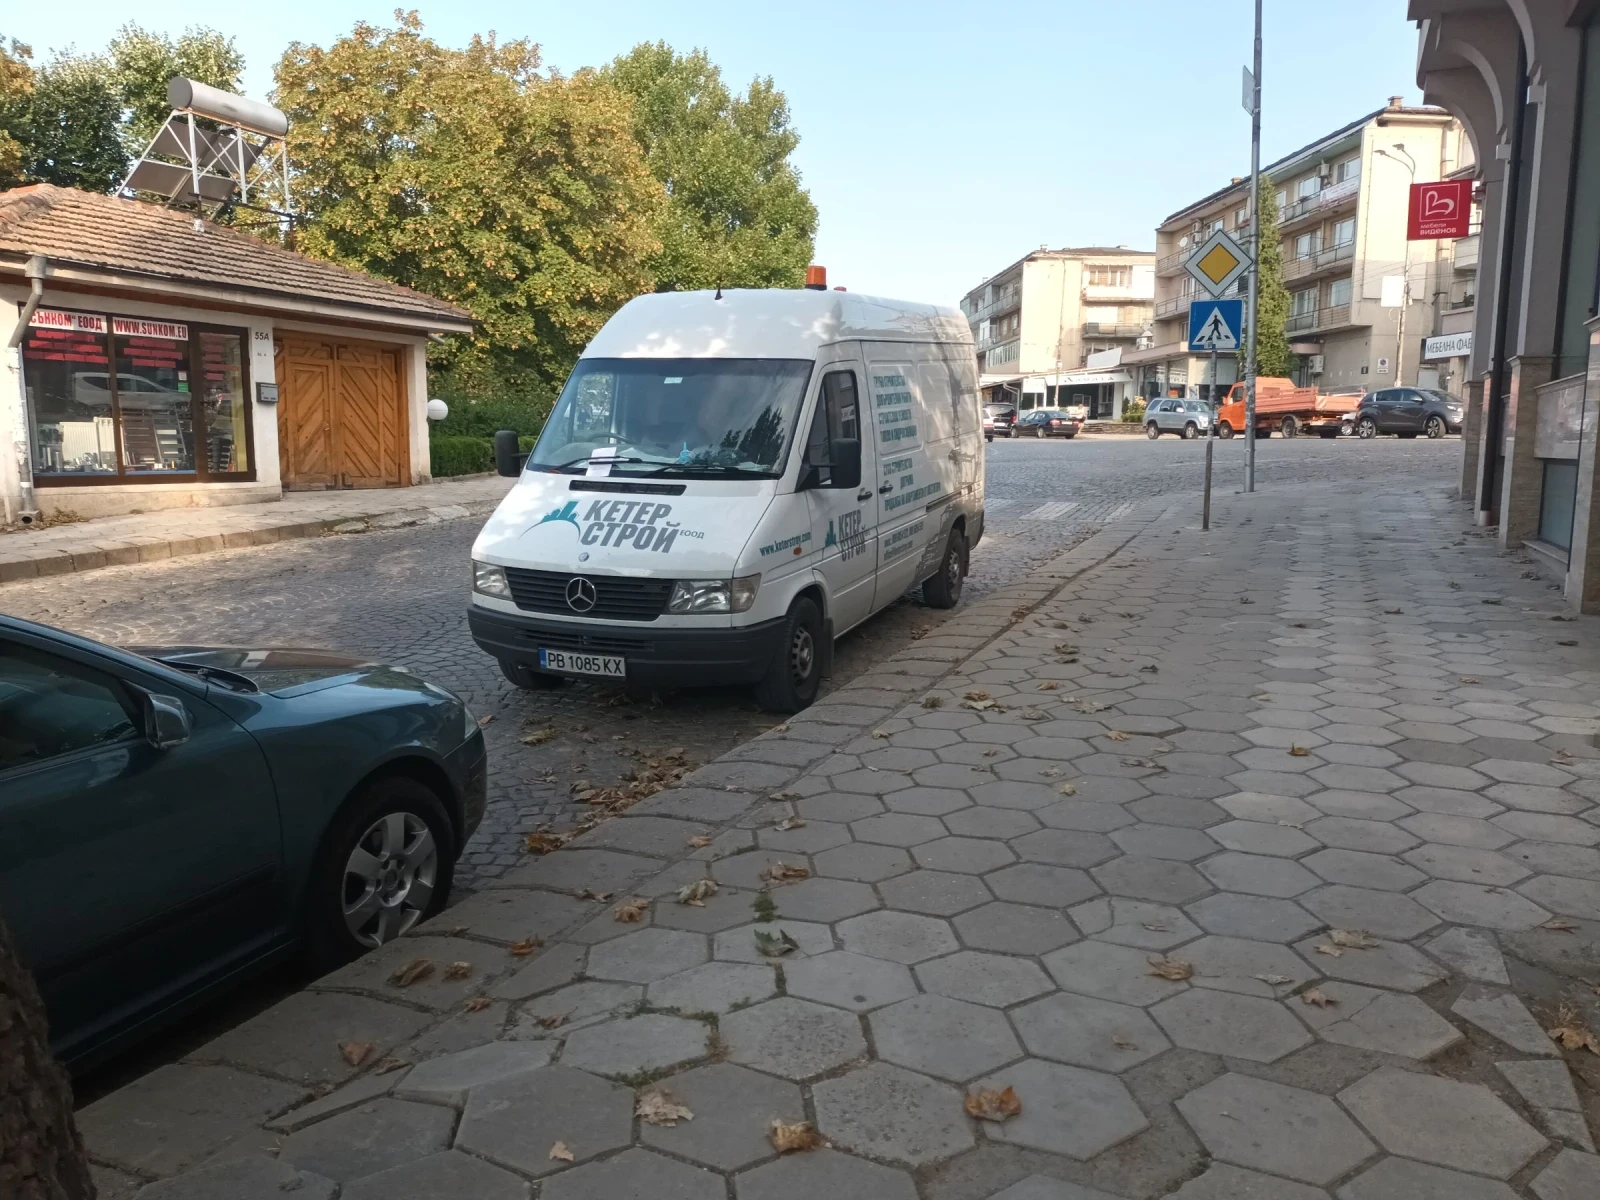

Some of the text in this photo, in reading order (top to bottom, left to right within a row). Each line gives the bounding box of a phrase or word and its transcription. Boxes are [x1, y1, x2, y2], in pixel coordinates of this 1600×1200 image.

[77, 315, 103, 332] ЕООД
[114, 319, 187, 339] WWW.SUNKOM.EU
[582, 500, 672, 525] КЕТЕР
[838, 509, 862, 541] КЕТЕР
[580, 521, 705, 554] СТРОЙ ЕООД
[759, 531, 811, 557] www.keterstroy.com
[547, 652, 623, 674] PB 1085 KX
